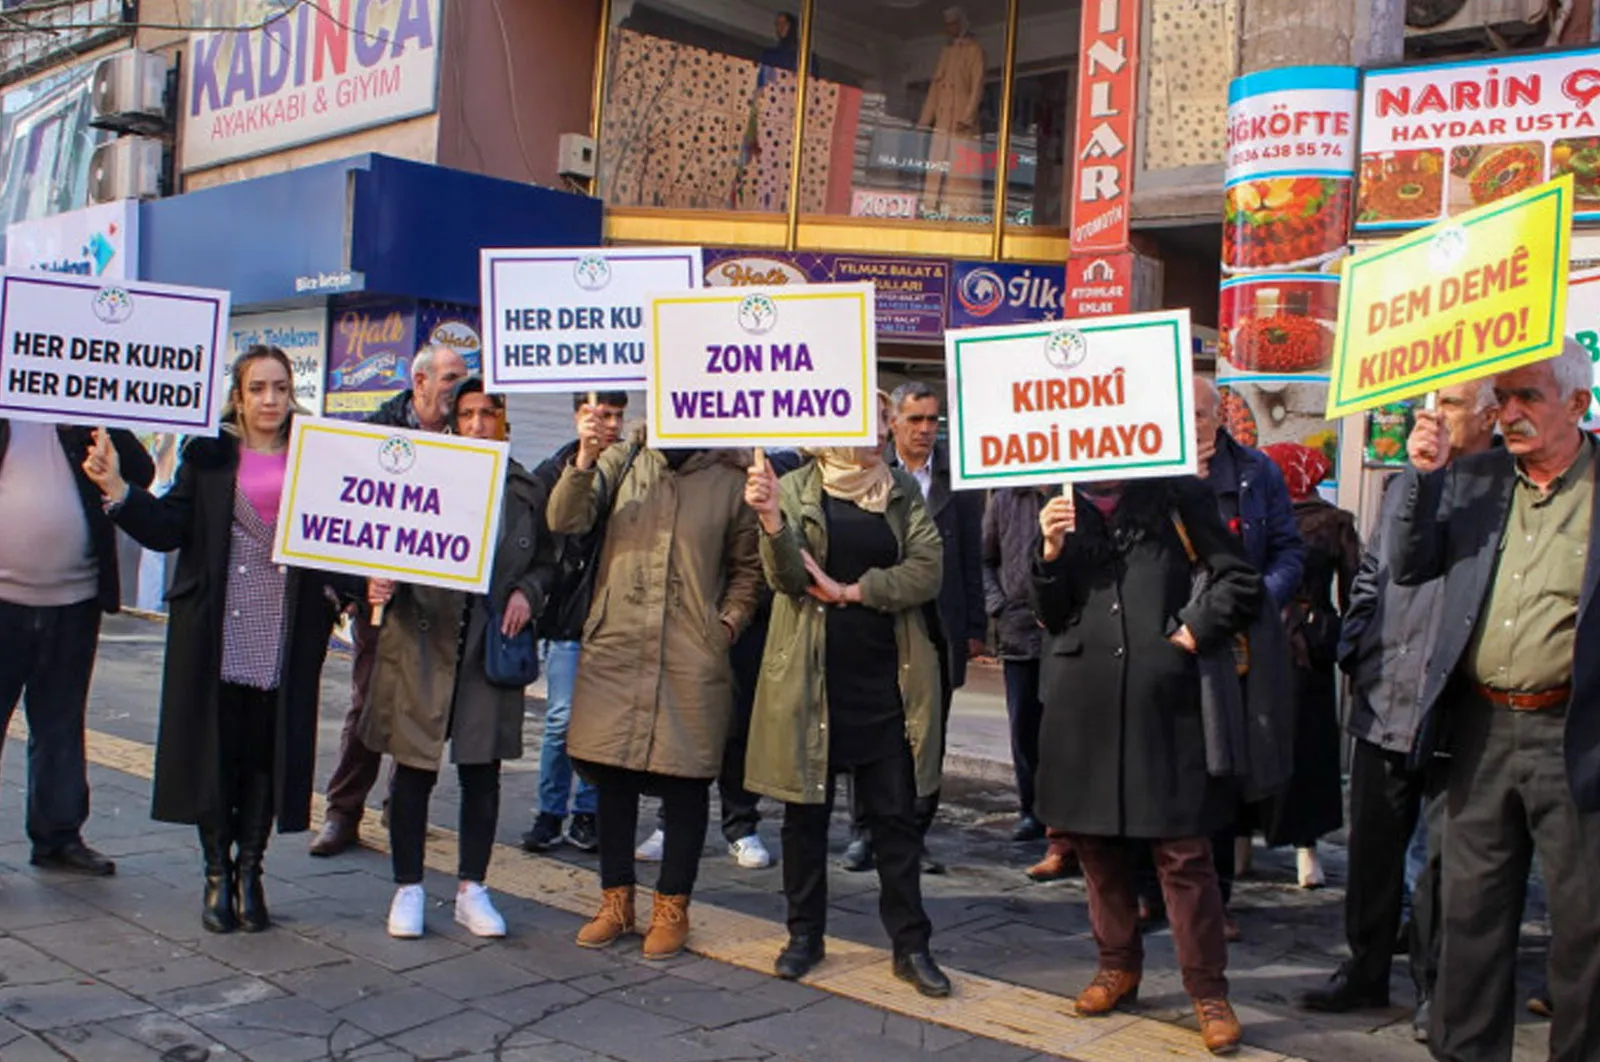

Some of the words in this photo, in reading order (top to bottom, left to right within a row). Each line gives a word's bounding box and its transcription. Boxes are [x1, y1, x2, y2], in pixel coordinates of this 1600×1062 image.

[211, 94, 308, 140] AYAKKABI
[312, 86, 328, 114] &
[336, 65, 401, 108] GİYİM
[1376, 68, 1541, 118] NARİN
[1391, 118, 1507, 142] HAYDAR
[1516, 111, 1595, 133] USTA
[1262, 144, 1292, 159] 438
[1296, 142, 1318, 156] 55
[1321, 142, 1343, 157] 74
[840, 263, 887, 275] YILMAZ
[890, 265, 931, 276] BALAT
[1007, 269, 1066, 308] İlk
[1367, 285, 1431, 336] DEM
[1438, 245, 1530, 313] DEMÊ
[504, 307, 552, 331] HER
[558, 306, 605, 330] DER
[13, 331, 64, 360] HER
[69, 337, 120, 365] DER
[126, 342, 205, 373] KURDÎ
[504, 344, 552, 367] HER
[557, 343, 608, 366] DEM
[706, 344, 763, 374] ZON
[770, 342, 814, 372] MA
[1358, 320, 1466, 390] KIRDKÎ
[1472, 306, 1530, 355] YO!
[8, 368, 60, 396] HER
[65, 374, 119, 402] DEM
[124, 379, 203, 409] KURDÎ
[671, 389, 765, 419] WELAT
[772, 387, 852, 418] MAYO
[1012, 366, 1126, 414] KIRDKÎ
[979, 423, 1060, 468] DADİ
[1068, 421, 1164, 461] MAYO
[339, 475, 396, 509] ZON
[400, 483, 441, 516] MA
[301, 512, 391, 551] WELAT
[394, 525, 471, 563] MAYO
